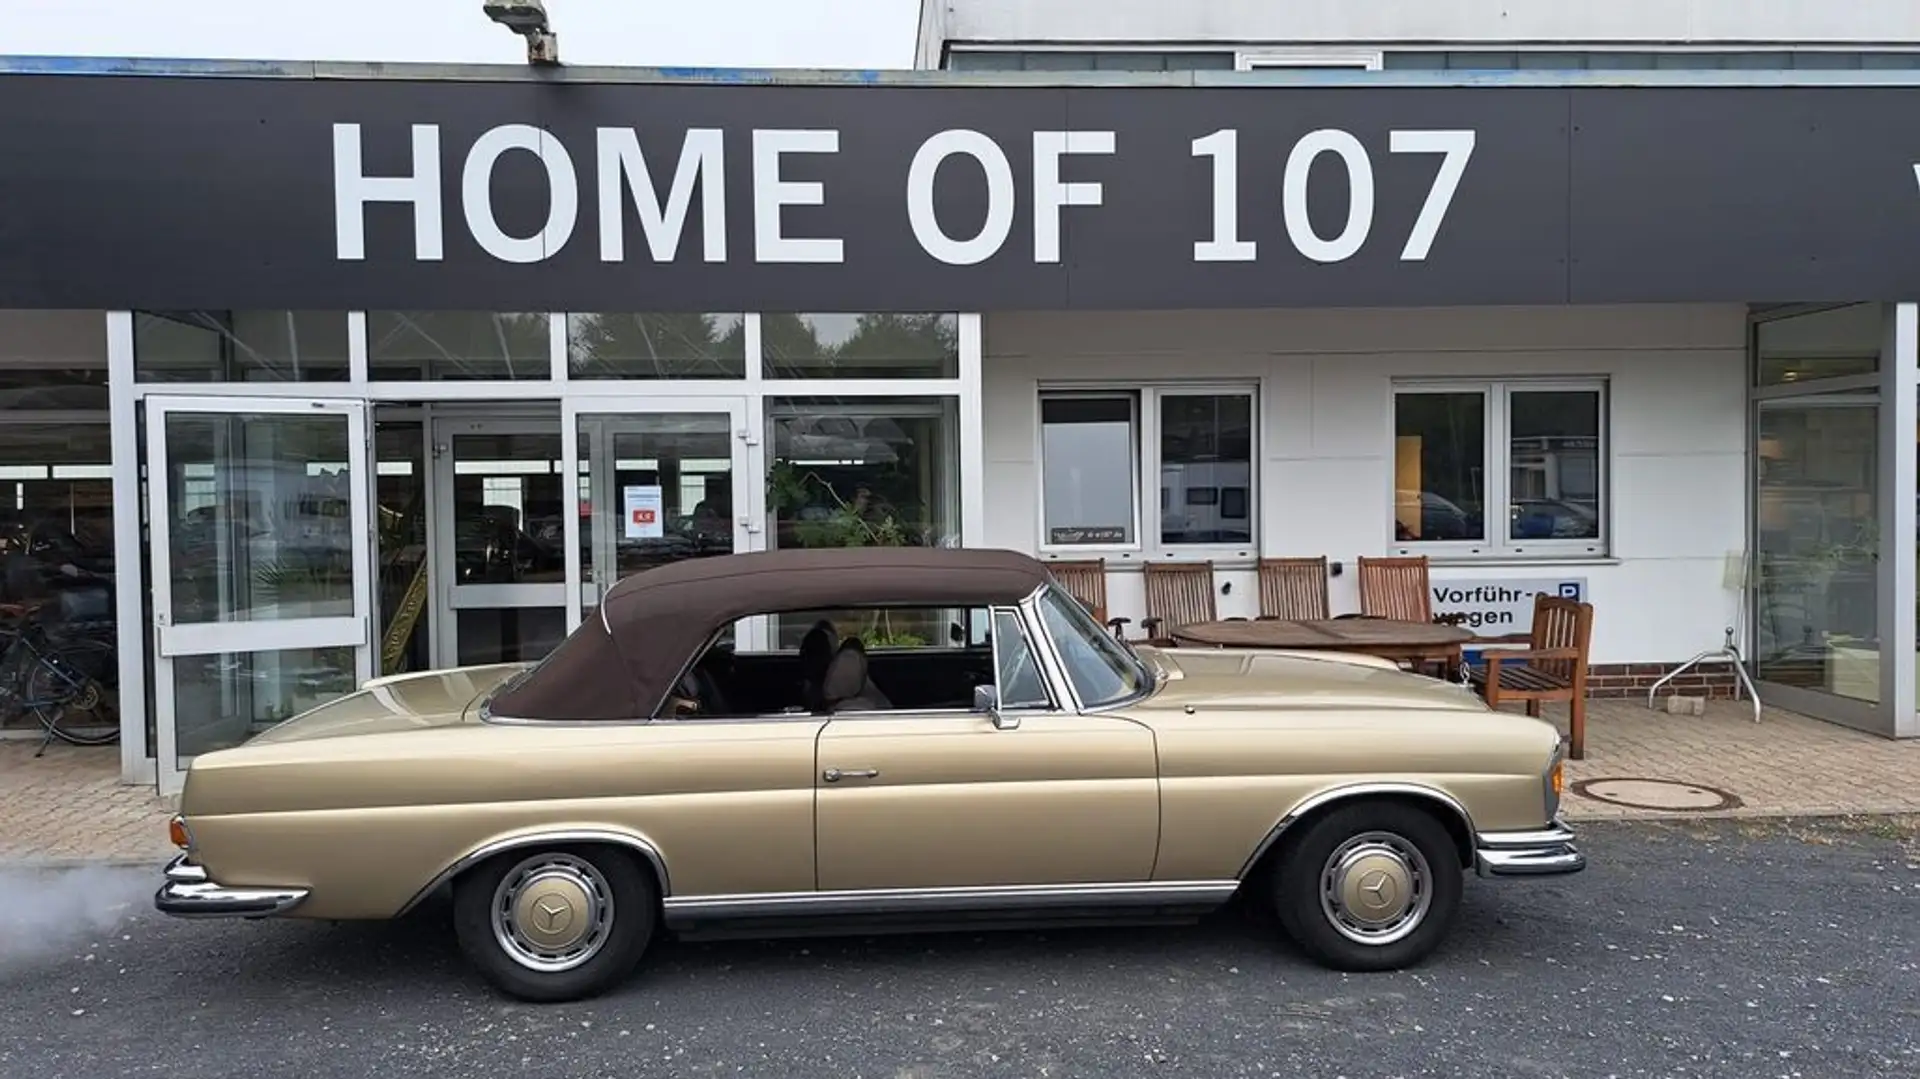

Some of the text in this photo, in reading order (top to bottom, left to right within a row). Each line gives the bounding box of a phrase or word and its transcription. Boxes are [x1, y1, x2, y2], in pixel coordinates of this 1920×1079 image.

[333, 123, 1476, 265] HOME OF 107
[1433, 586, 1533, 603] Vorführ-
